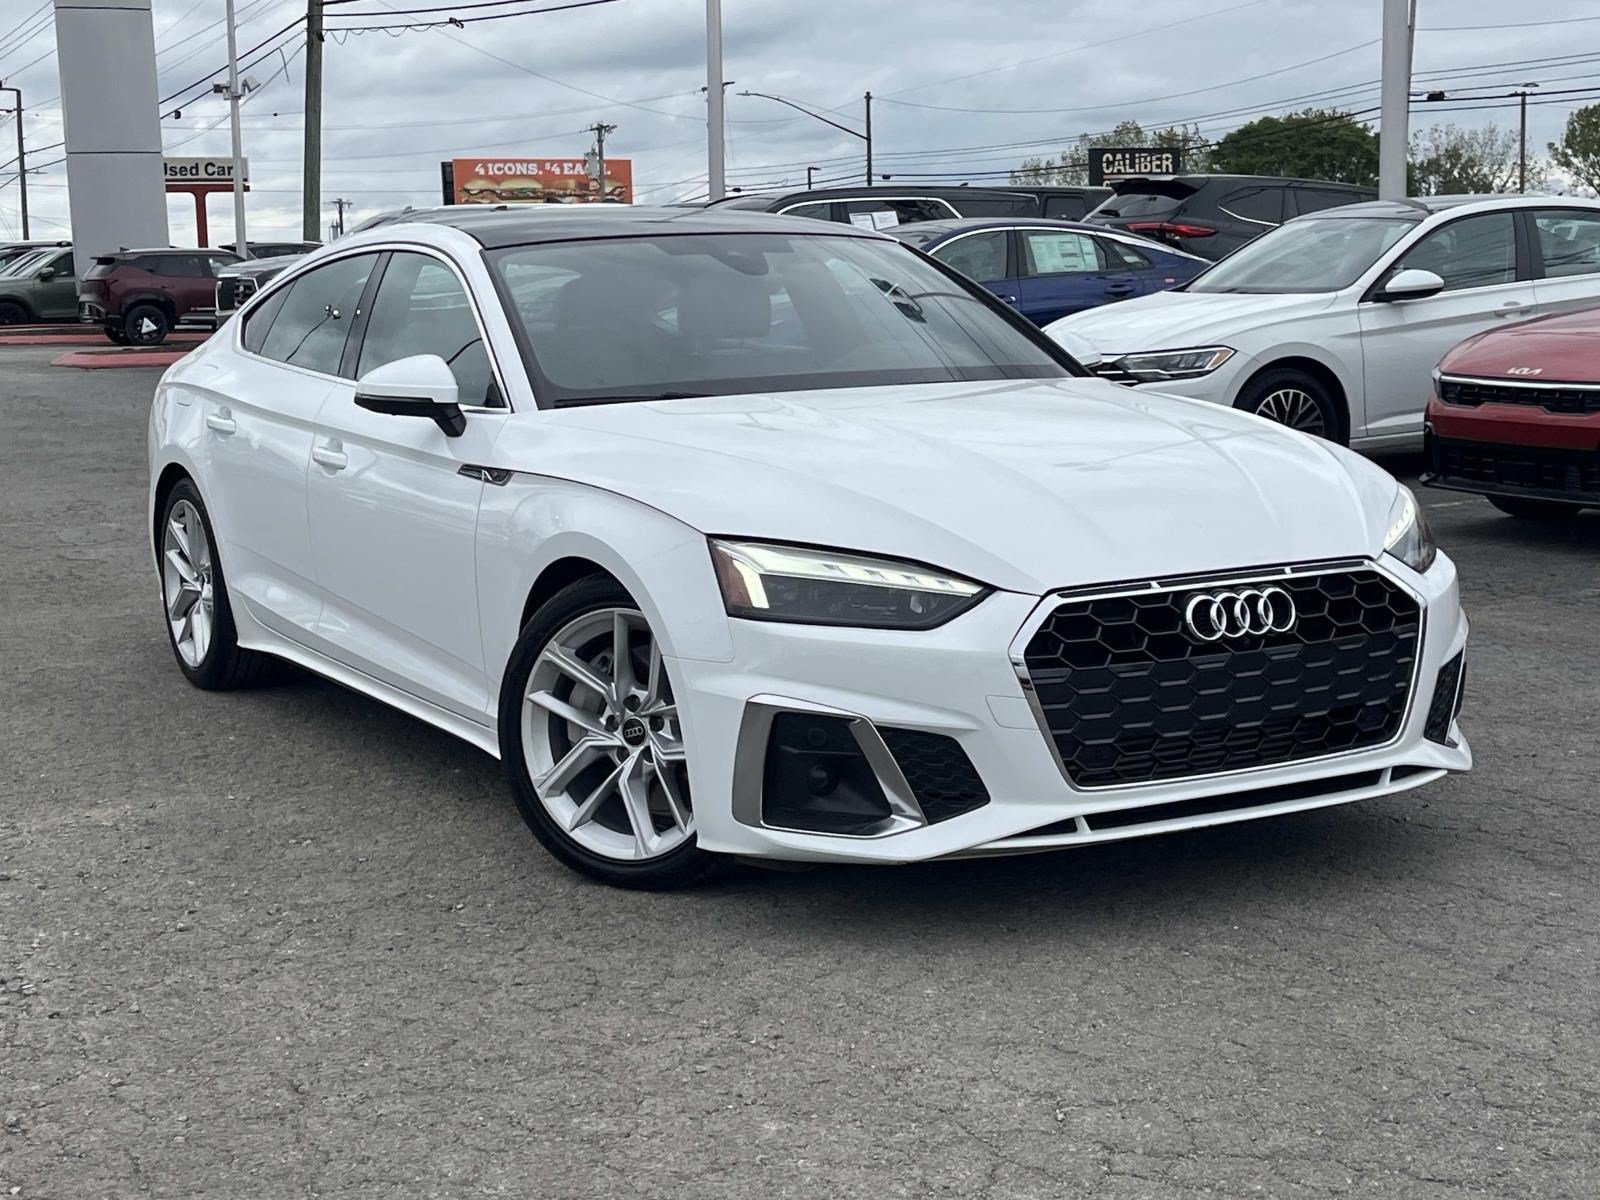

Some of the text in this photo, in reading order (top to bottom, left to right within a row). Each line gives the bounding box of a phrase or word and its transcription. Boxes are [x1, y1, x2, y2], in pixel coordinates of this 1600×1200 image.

[204, 162, 234, 177] Car
[474, 163, 486, 176] 4
[487, 163, 543, 176] ICONS.
[1102, 153, 1173, 173] CALIBER
